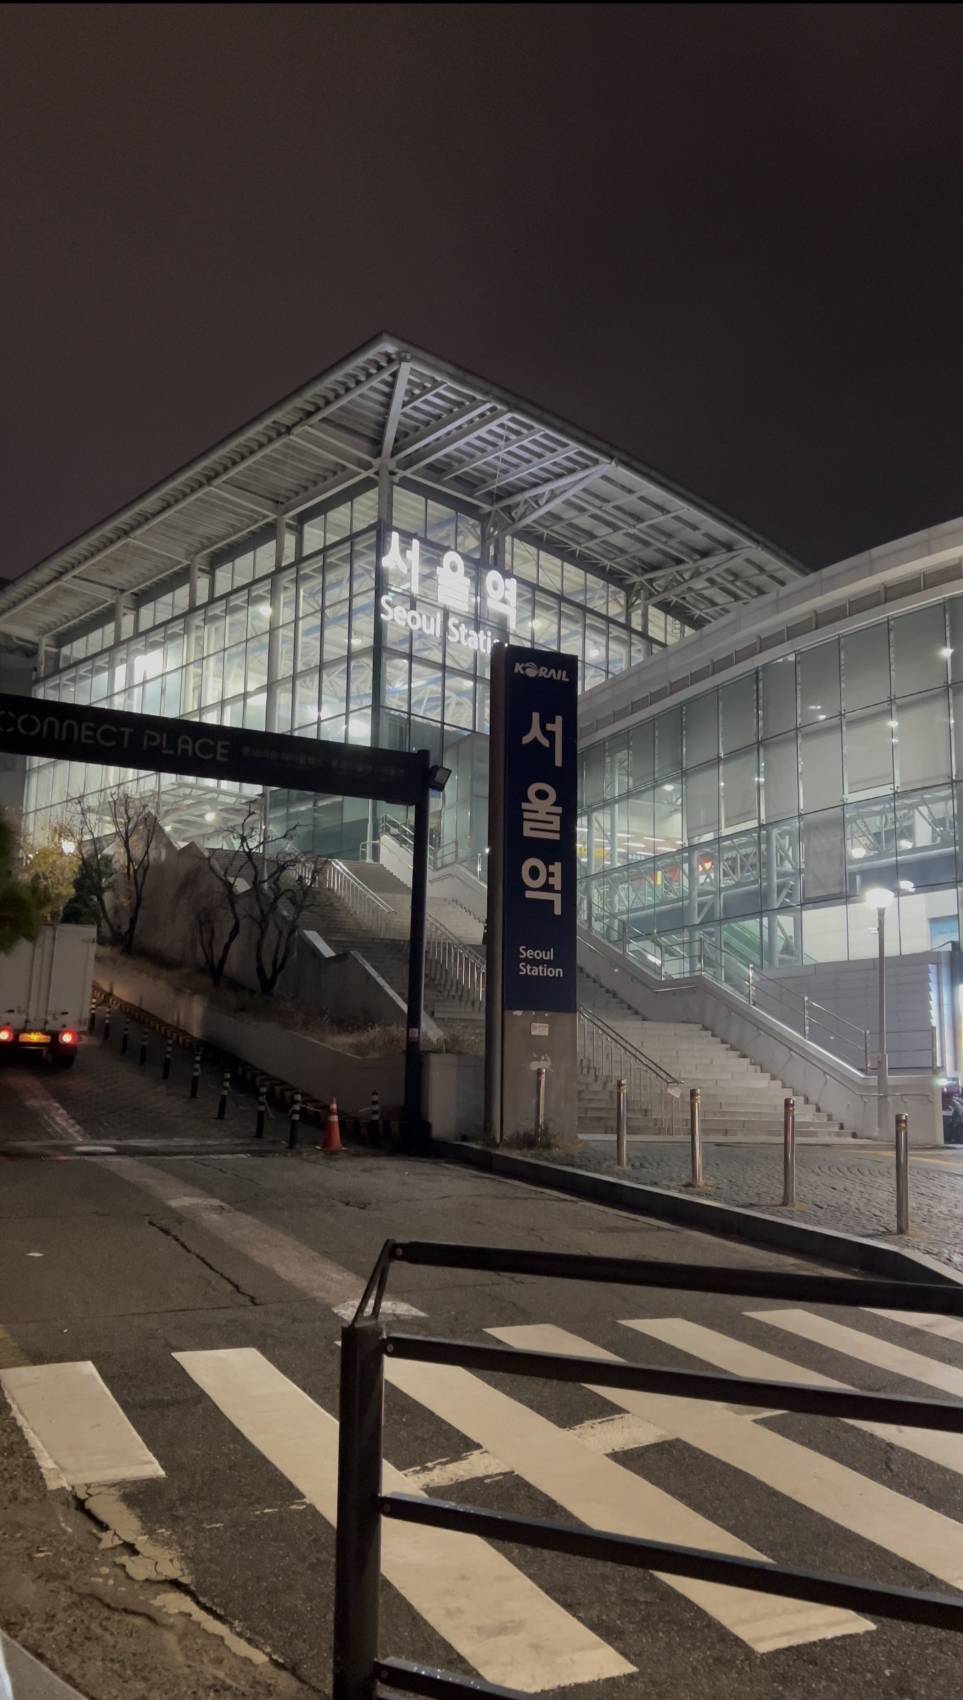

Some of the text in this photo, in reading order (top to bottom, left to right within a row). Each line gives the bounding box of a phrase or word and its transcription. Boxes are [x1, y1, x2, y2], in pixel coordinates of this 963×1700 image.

[382, 531, 517, 630] 서울역
[380, 594, 500, 654] Seoul Stati
[514, 661, 570, 682] KORAIL
[143, 730, 231, 762] PLACE
[521, 711, 563, 916] 서울역
[519, 945, 554, 961] Seoul
[519, 962, 564, 978] Station
